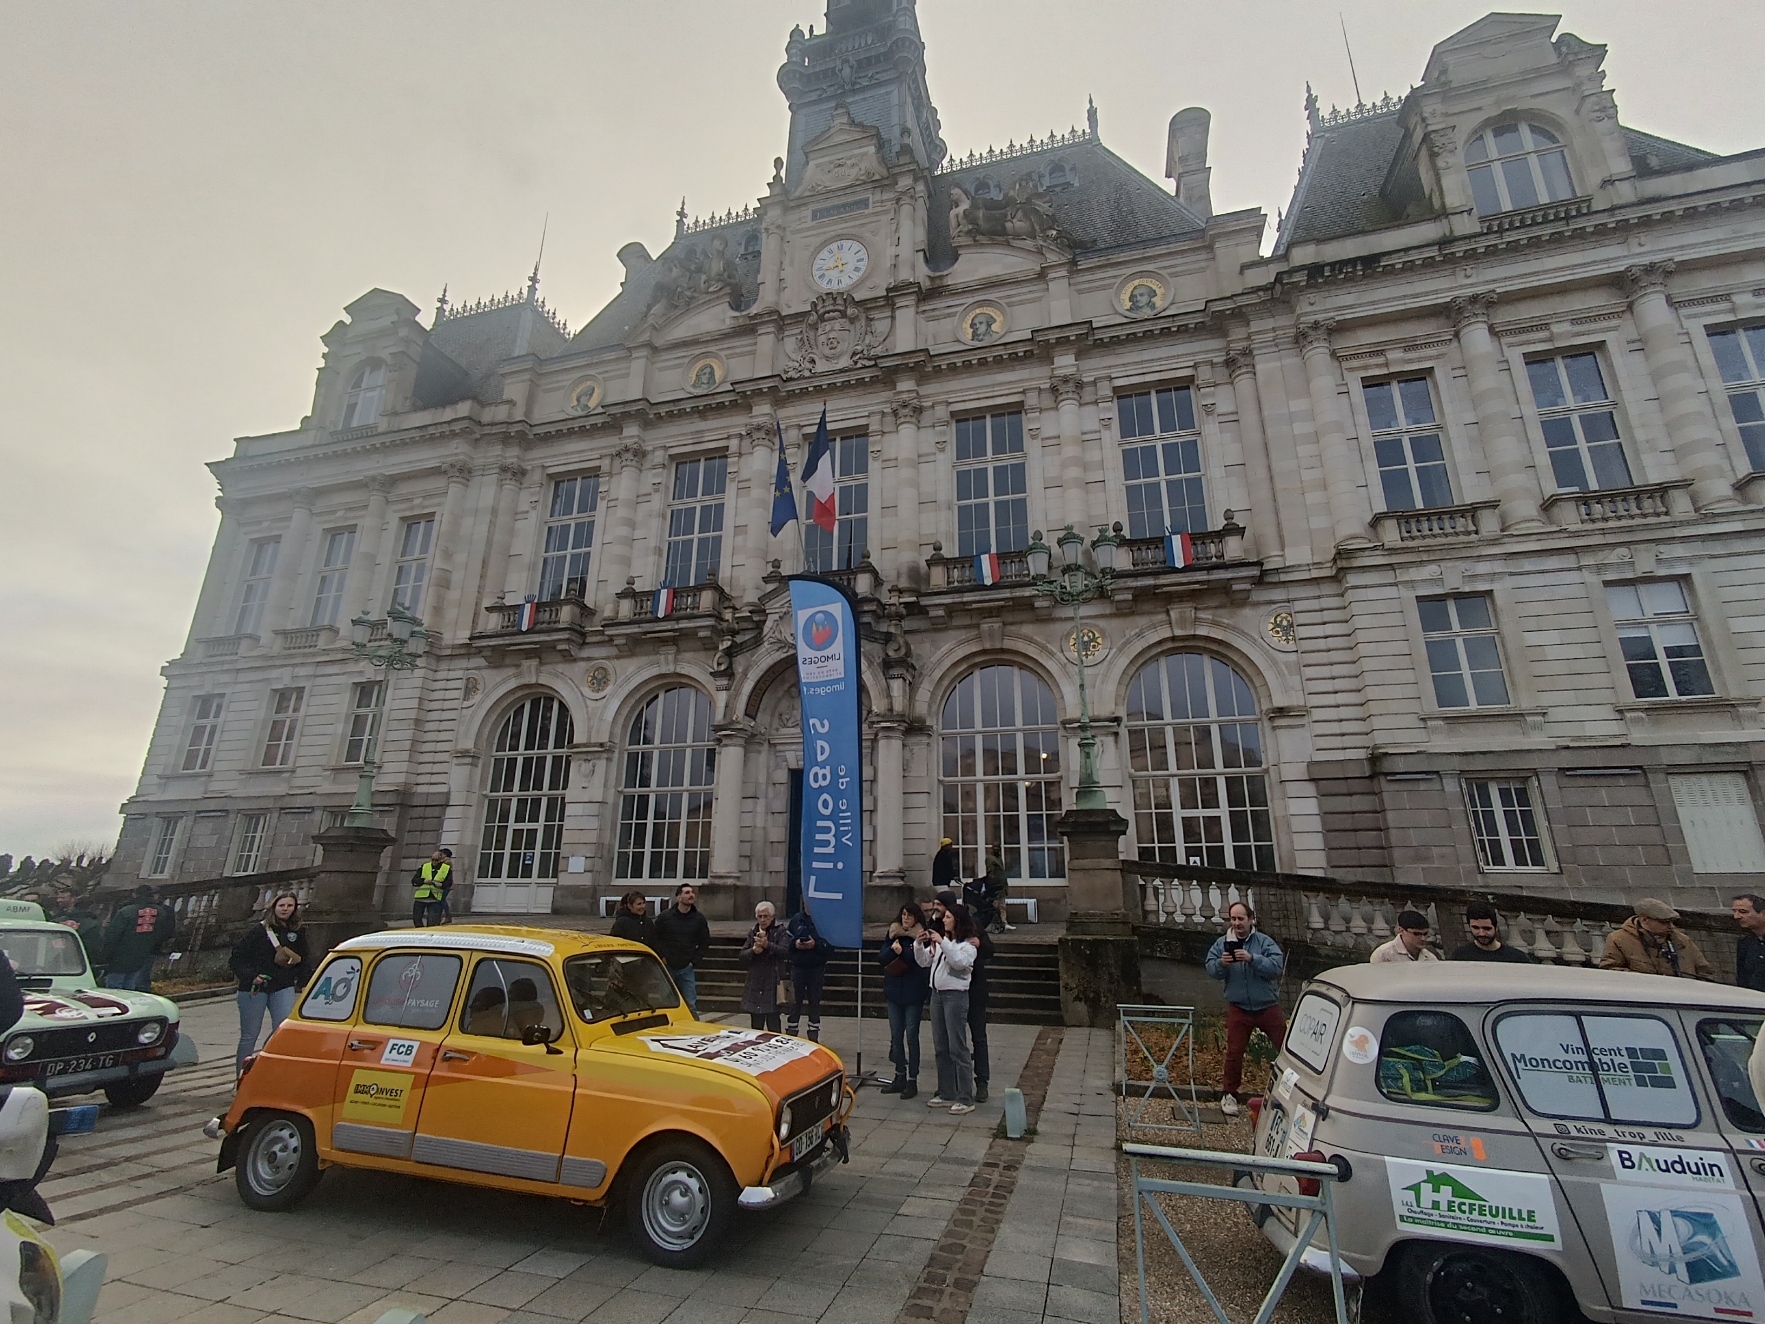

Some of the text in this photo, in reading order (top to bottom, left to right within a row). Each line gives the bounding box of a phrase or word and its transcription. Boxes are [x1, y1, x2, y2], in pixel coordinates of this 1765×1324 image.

[388, 1043, 414, 1056] FCB
[1559, 1042, 1625, 1058] Vincent
[1511, 1052, 1630, 1080] Moncomble
[1432, 1133, 1461, 1145] CLAVE
[1420, 1182, 1537, 1223] HECFEUILLE
[1407, 1208, 1434, 1218] Chauffage
[1447, 1220, 1458, 1229] du
